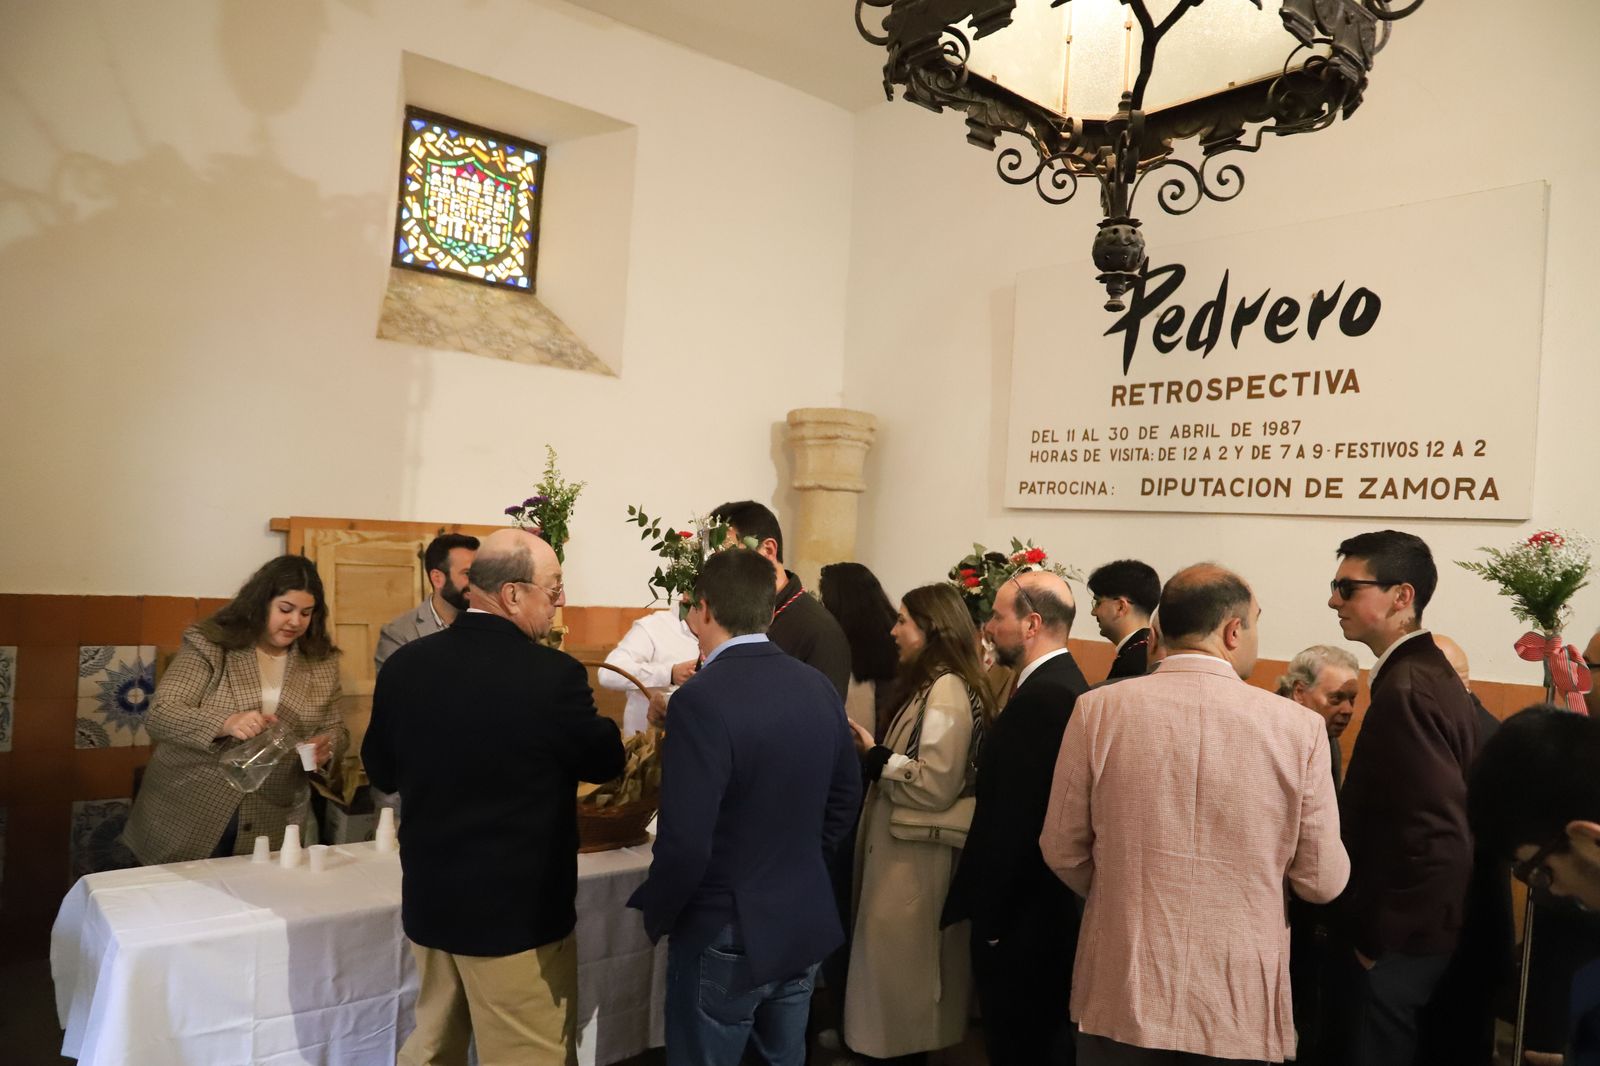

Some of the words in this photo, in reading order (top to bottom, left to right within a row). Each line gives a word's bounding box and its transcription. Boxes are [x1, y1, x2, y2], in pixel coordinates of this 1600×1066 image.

[1103, 257, 1382, 377] Pedrero
[1110, 368, 1361, 408] RETROSPECTIVA
[1031, 429, 1060, 444] DEL
[1066, 429, 1076, 443] 11
[1081, 428, 1100, 442] AL
[1108, 427, 1129, 441] 30
[1138, 425, 1160, 440] DE
[1169, 423, 1221, 440] ABRIL
[1231, 422, 1253, 437] DE
[1262, 420, 1302, 436] 1987
[1030, 449, 1079, 463] HORAS
[1083, 448, 1101, 462] DE
[1110, 447, 1155, 462] VISITA:
[1158, 447, 1177, 462] DE
[1183, 446, 1198, 461] 12
[1202, 446, 1212, 461] A
[1218, 446, 1228, 461] 2
[1234, 445, 1244, 460] Y
[1251, 445, 1272, 460] DE
[1280, 444, 1291, 460] 7
[1295, 444, 1306, 460] A
[1426, 440, 1445, 458] 12
[1452, 440, 1464, 457] A
[1473, 439, 1487, 457] 2
[1019, 481, 1116, 496] PATROCINA:
[1140, 477, 1293, 498] DIPUTACION
[1304, 477, 1344, 499] DE
[1358, 477, 1501, 501] ZAMORA
